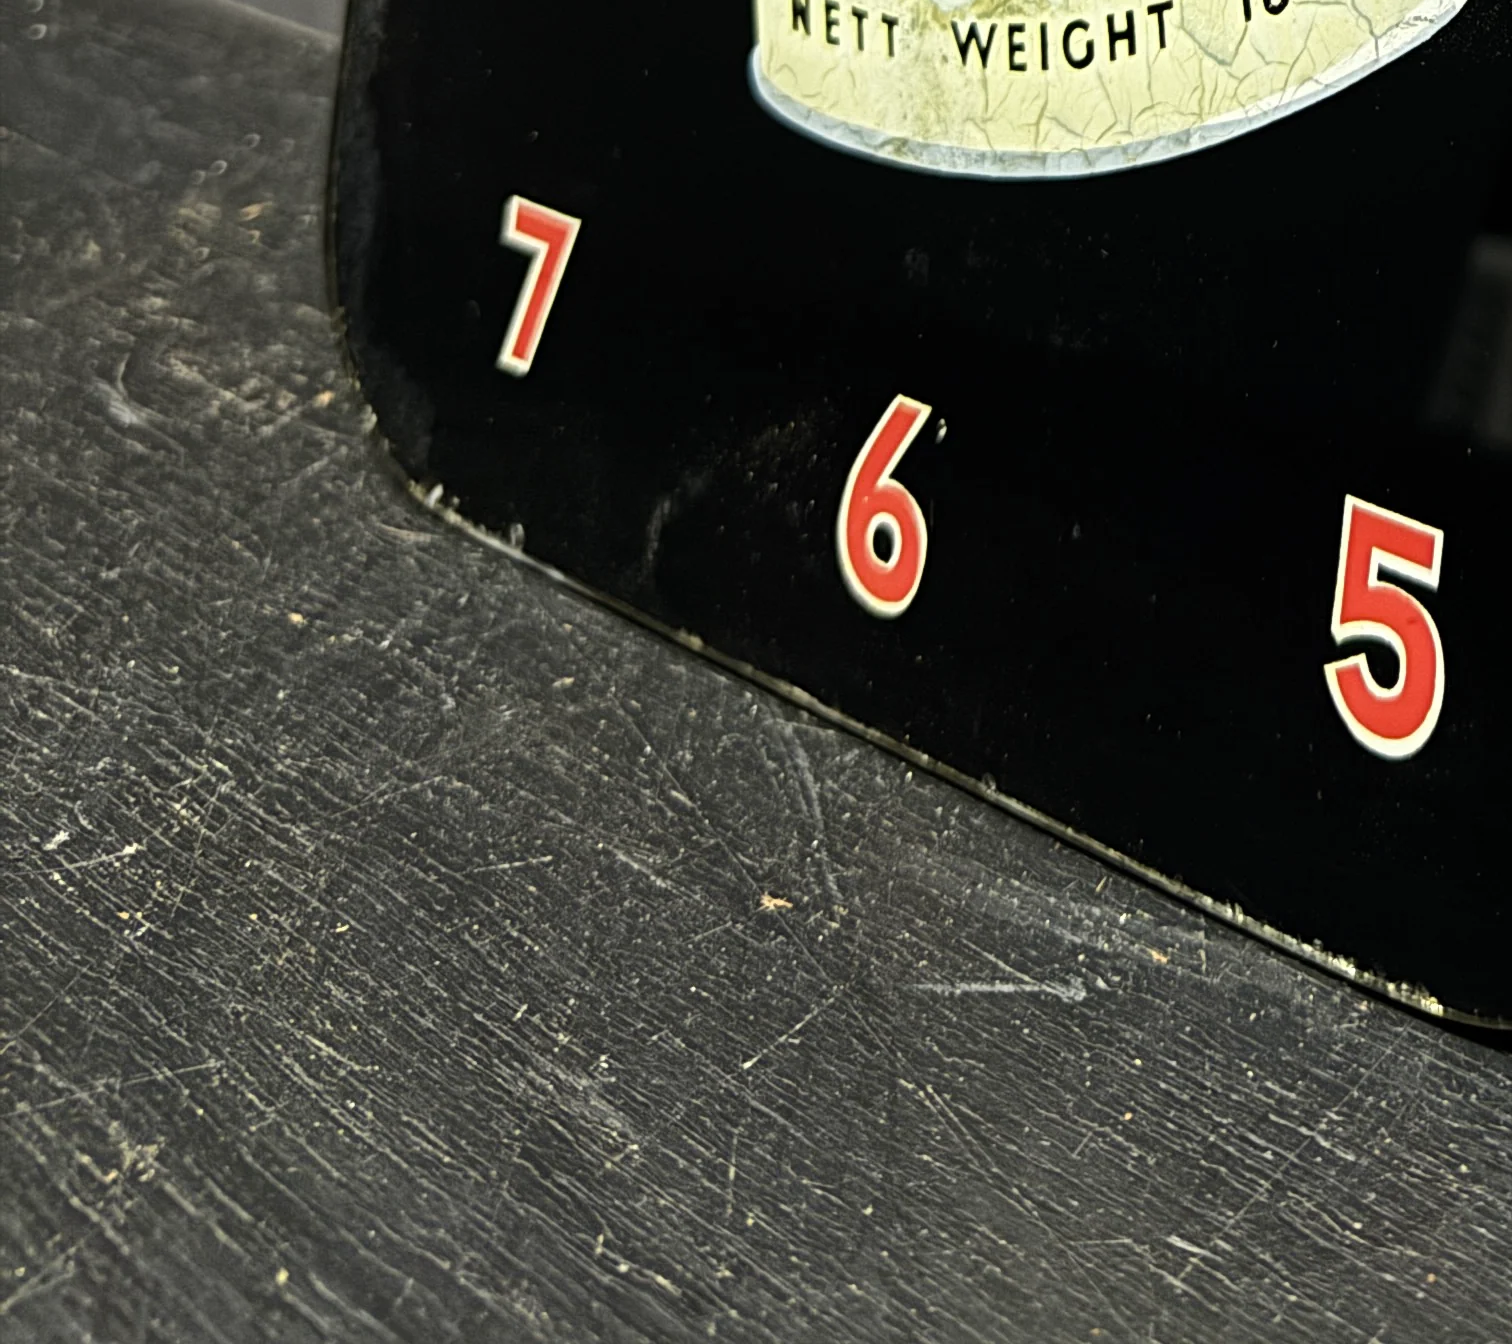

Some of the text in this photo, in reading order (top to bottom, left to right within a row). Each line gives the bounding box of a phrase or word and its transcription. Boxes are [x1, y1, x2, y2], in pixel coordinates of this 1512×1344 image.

[950, 0, 1174, 73] WEIGHT
[498, 194, 582, 375] 7
[837, 394, 928, 617] 6
[1324, 494, 1446, 759] 5
